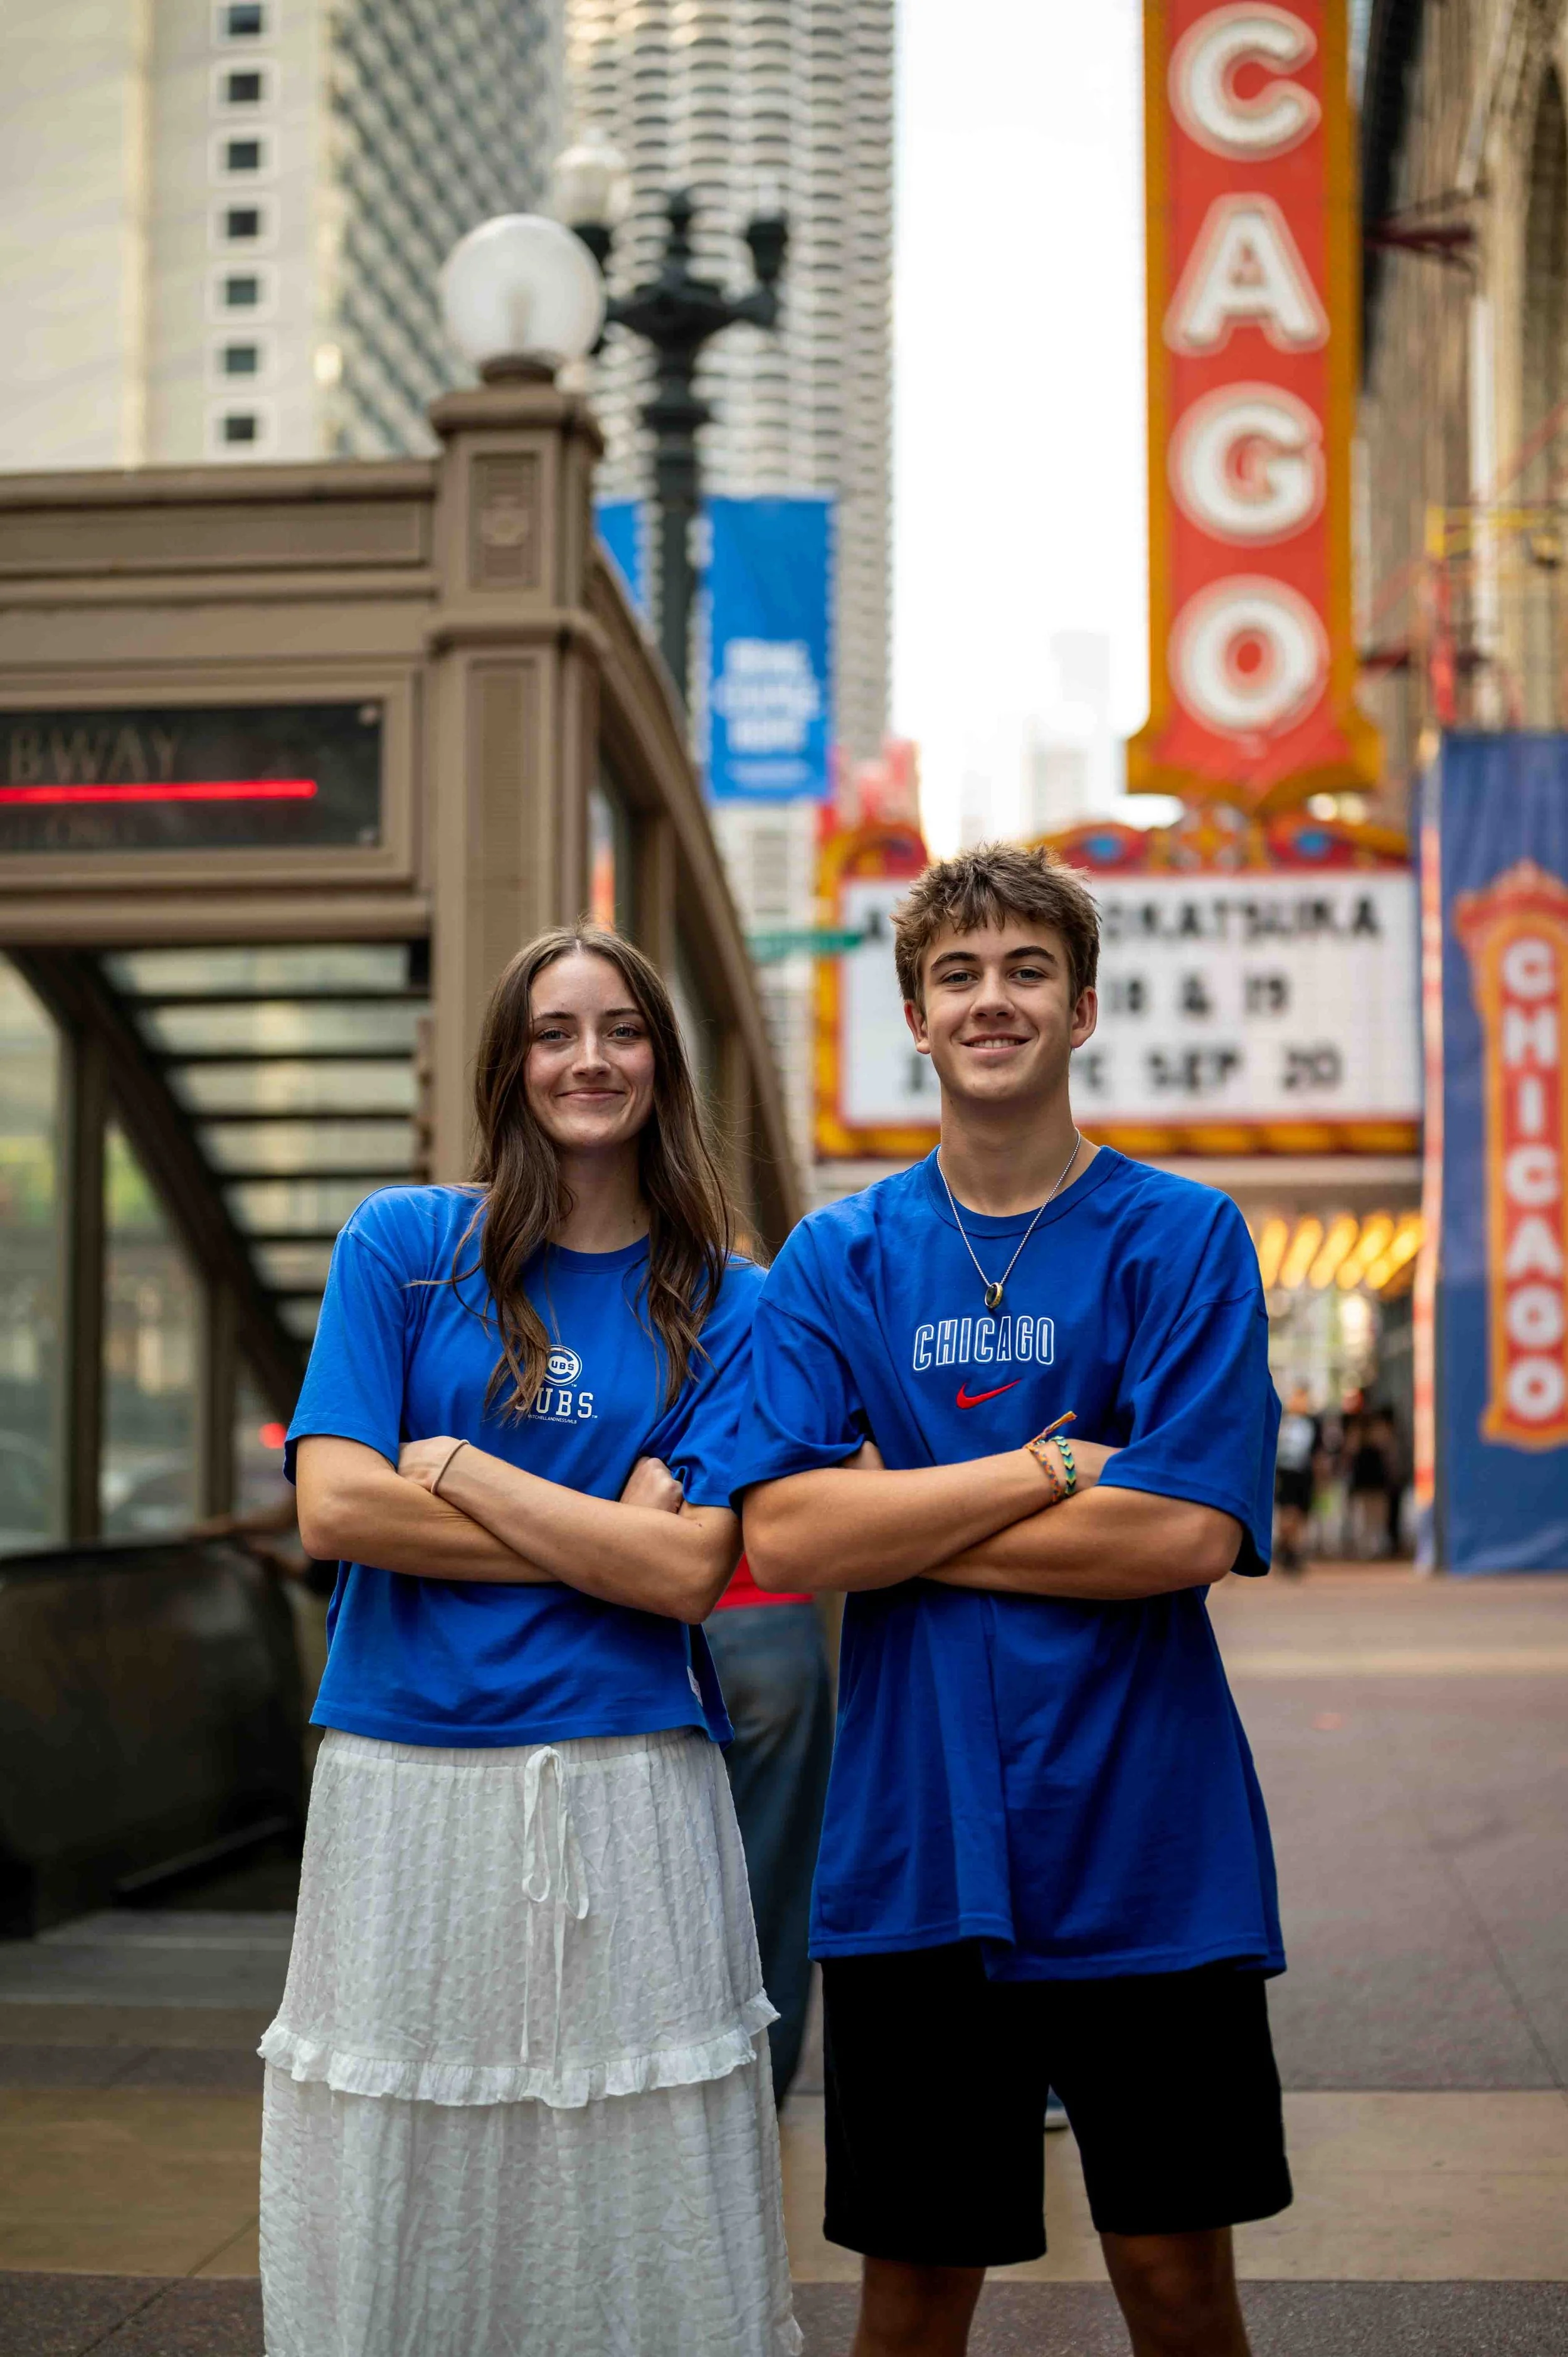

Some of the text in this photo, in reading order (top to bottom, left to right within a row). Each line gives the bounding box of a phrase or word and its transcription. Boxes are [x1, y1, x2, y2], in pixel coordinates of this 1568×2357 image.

[1163, 1, 1330, 742] CAGO
[9, 725, 184, 784] BWAY
[1179, 970, 1213, 1019] &
[1147, 1045, 1242, 1093] SEP
[1281, 1040, 1343, 1092] 20
[1503, 937, 1566, 1422] CHICAGO
[913, 1316, 1054, 1371] CHICAGO
